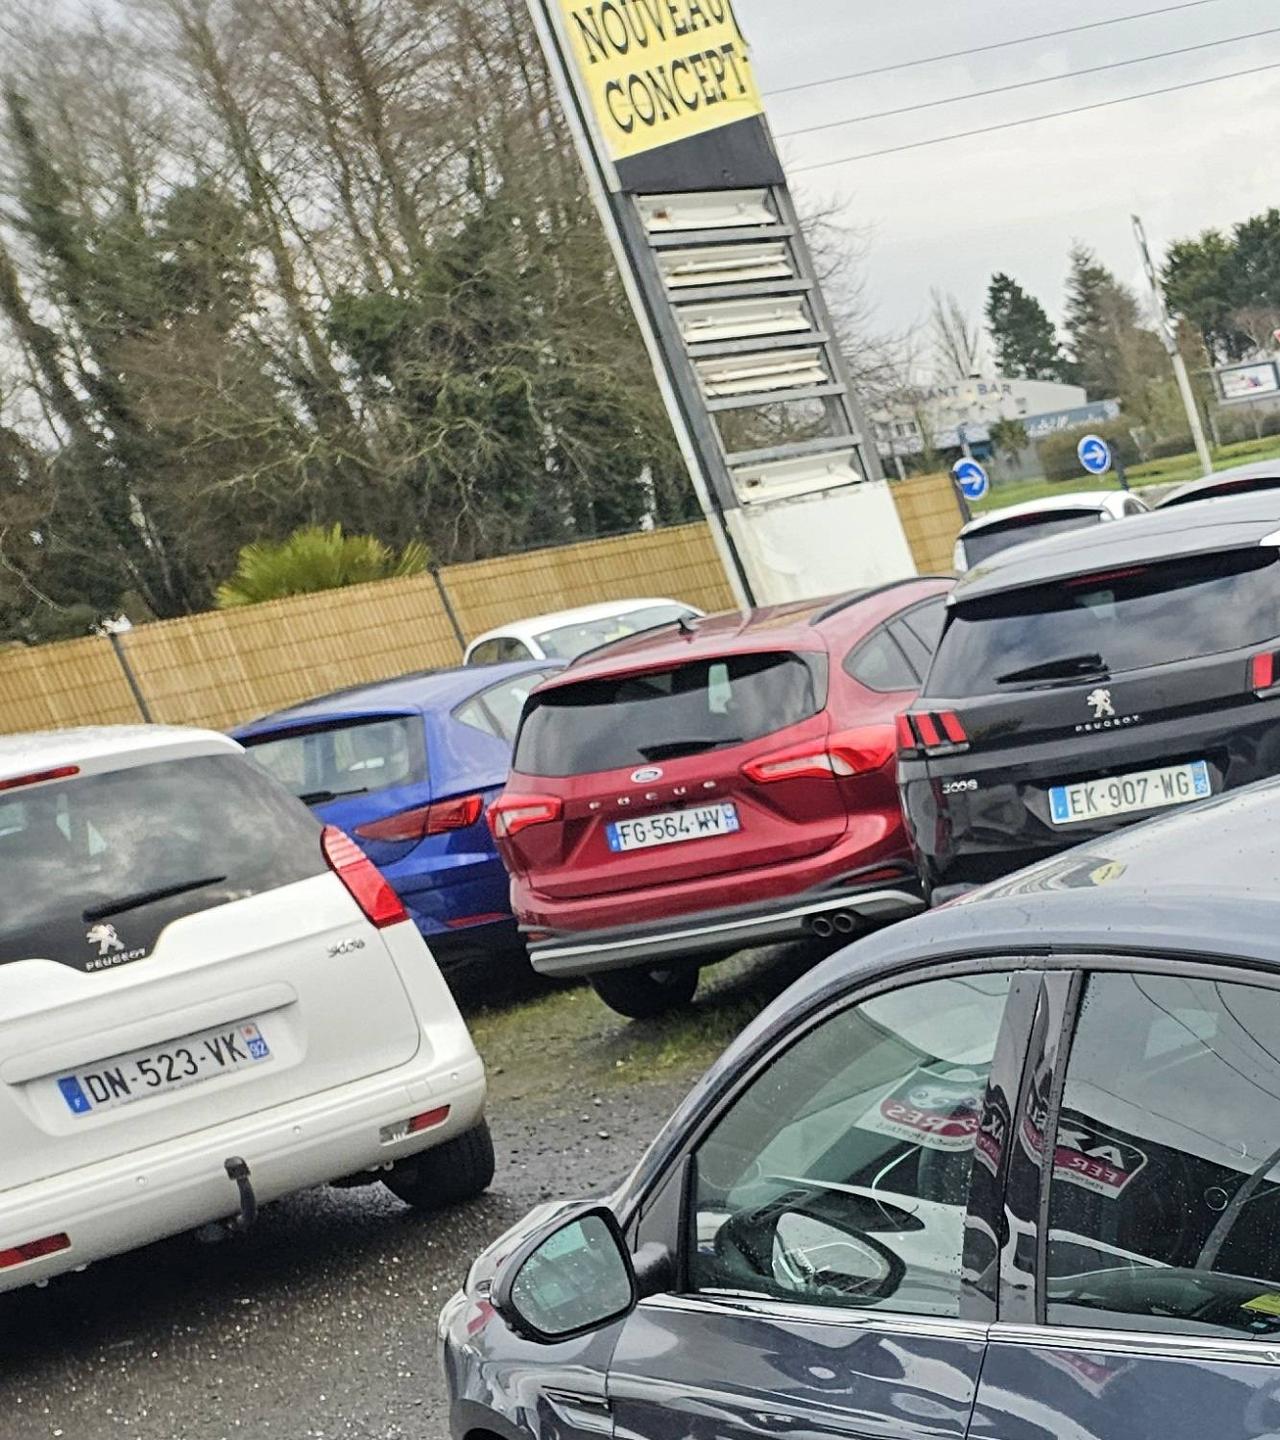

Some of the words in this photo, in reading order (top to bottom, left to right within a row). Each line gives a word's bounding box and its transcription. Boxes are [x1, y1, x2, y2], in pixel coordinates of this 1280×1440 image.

[571, 0, 725, 64] NOUVEAU
[604, 42, 749, 135] CONCEPT
[1068, 771, 1190, 816] EK-907-WG
[618, 808, 721, 847] FG-564-WV
[84, 1032, 248, 1104] DN-523-VK
